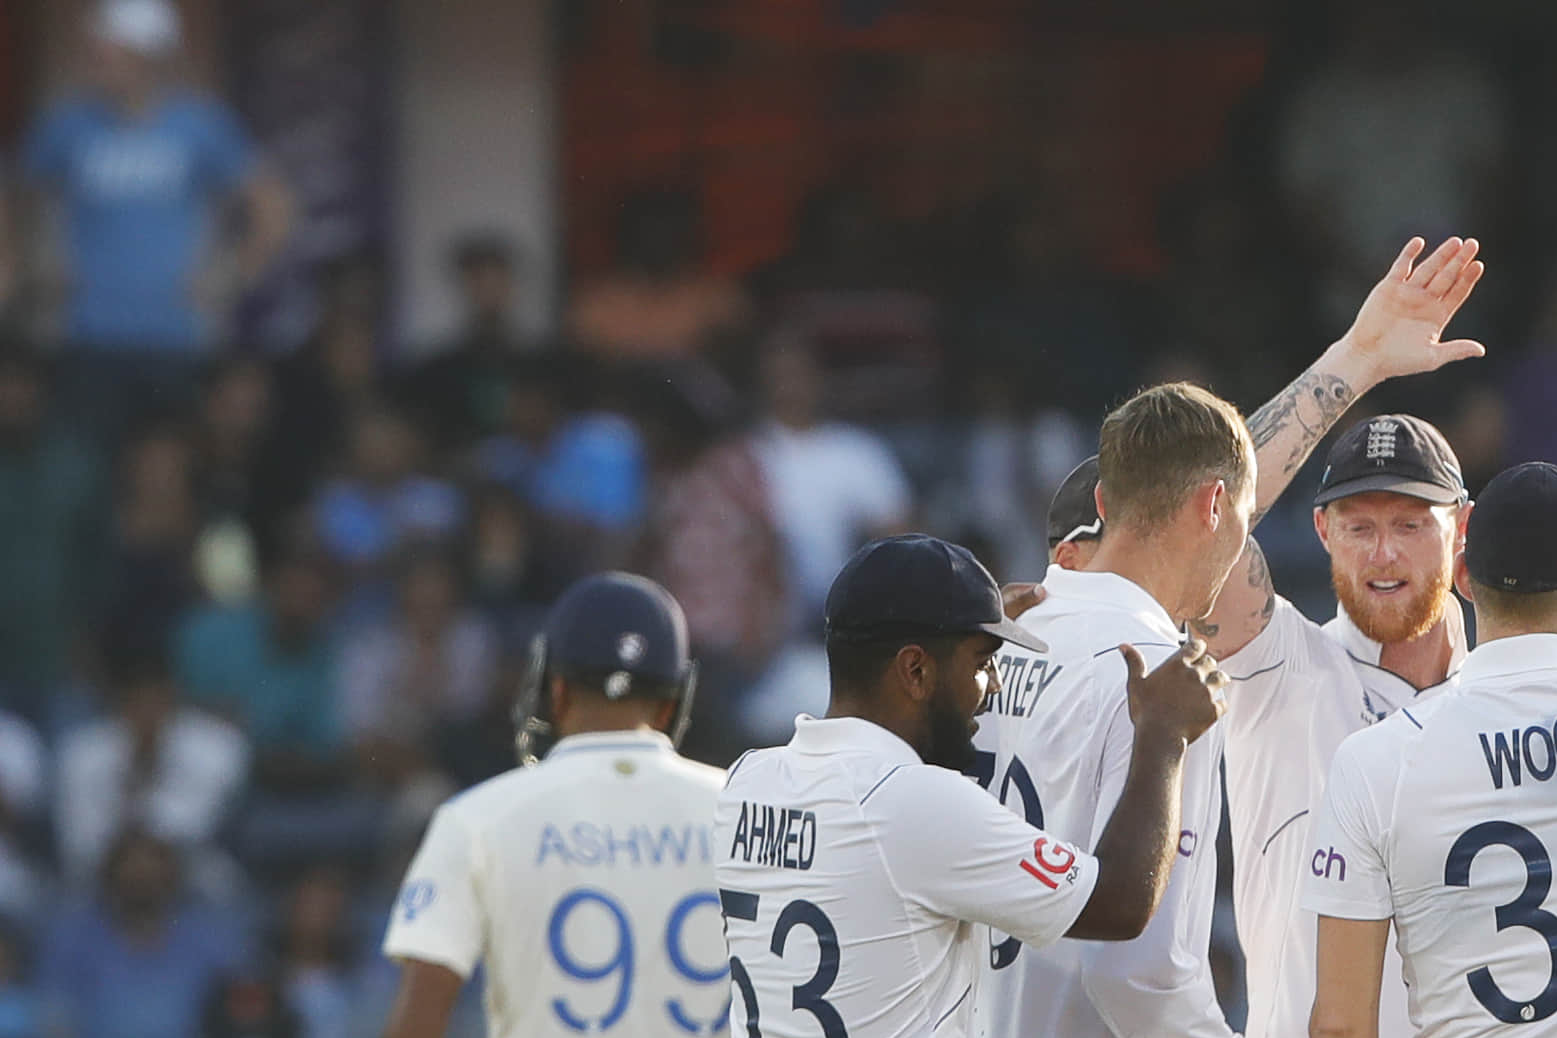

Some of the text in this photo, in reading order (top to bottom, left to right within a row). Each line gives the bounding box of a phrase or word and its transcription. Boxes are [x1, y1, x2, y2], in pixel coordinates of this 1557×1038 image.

[986, 653, 1064, 719] RTLEY
[536, 822, 712, 867] ASHWI
[730, 801, 817, 871] AHMED
[1019, 837, 1076, 890] IG
[548, 888, 731, 1033] 99
